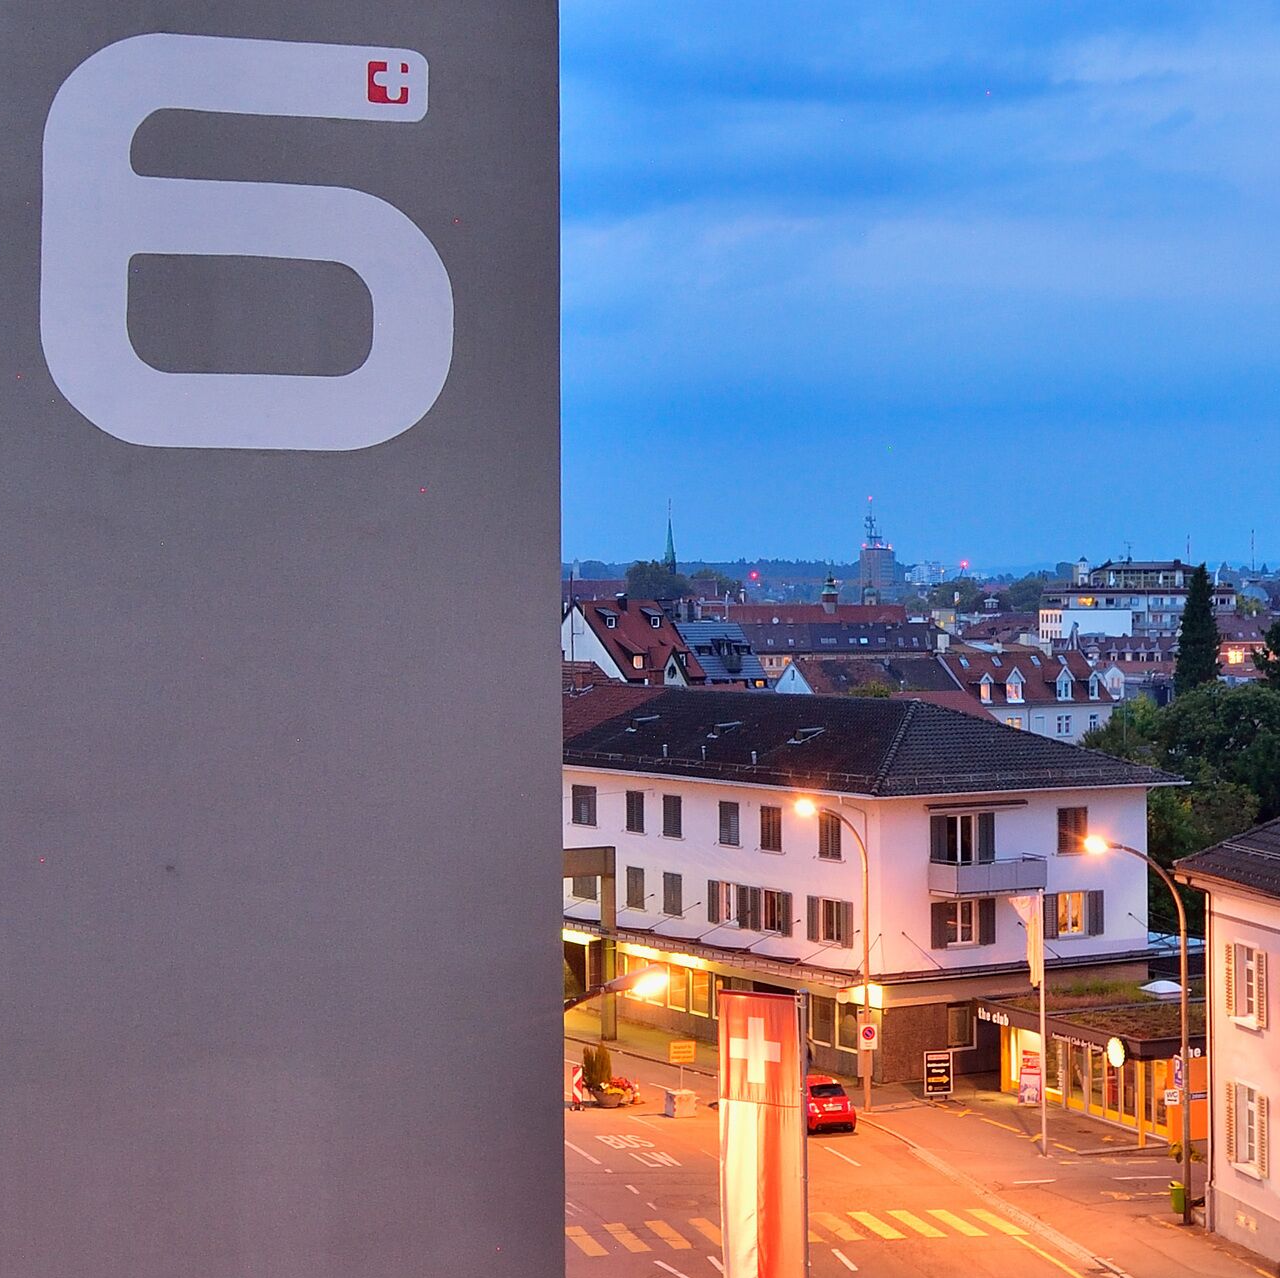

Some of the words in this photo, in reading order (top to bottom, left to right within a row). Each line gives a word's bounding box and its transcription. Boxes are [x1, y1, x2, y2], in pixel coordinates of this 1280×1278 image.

[40, 33, 454, 451] 6
[978, 1007, 991, 1021] the
[992, 1012, 1009, 1026] club
[594, 1134, 656, 1149] BUS
